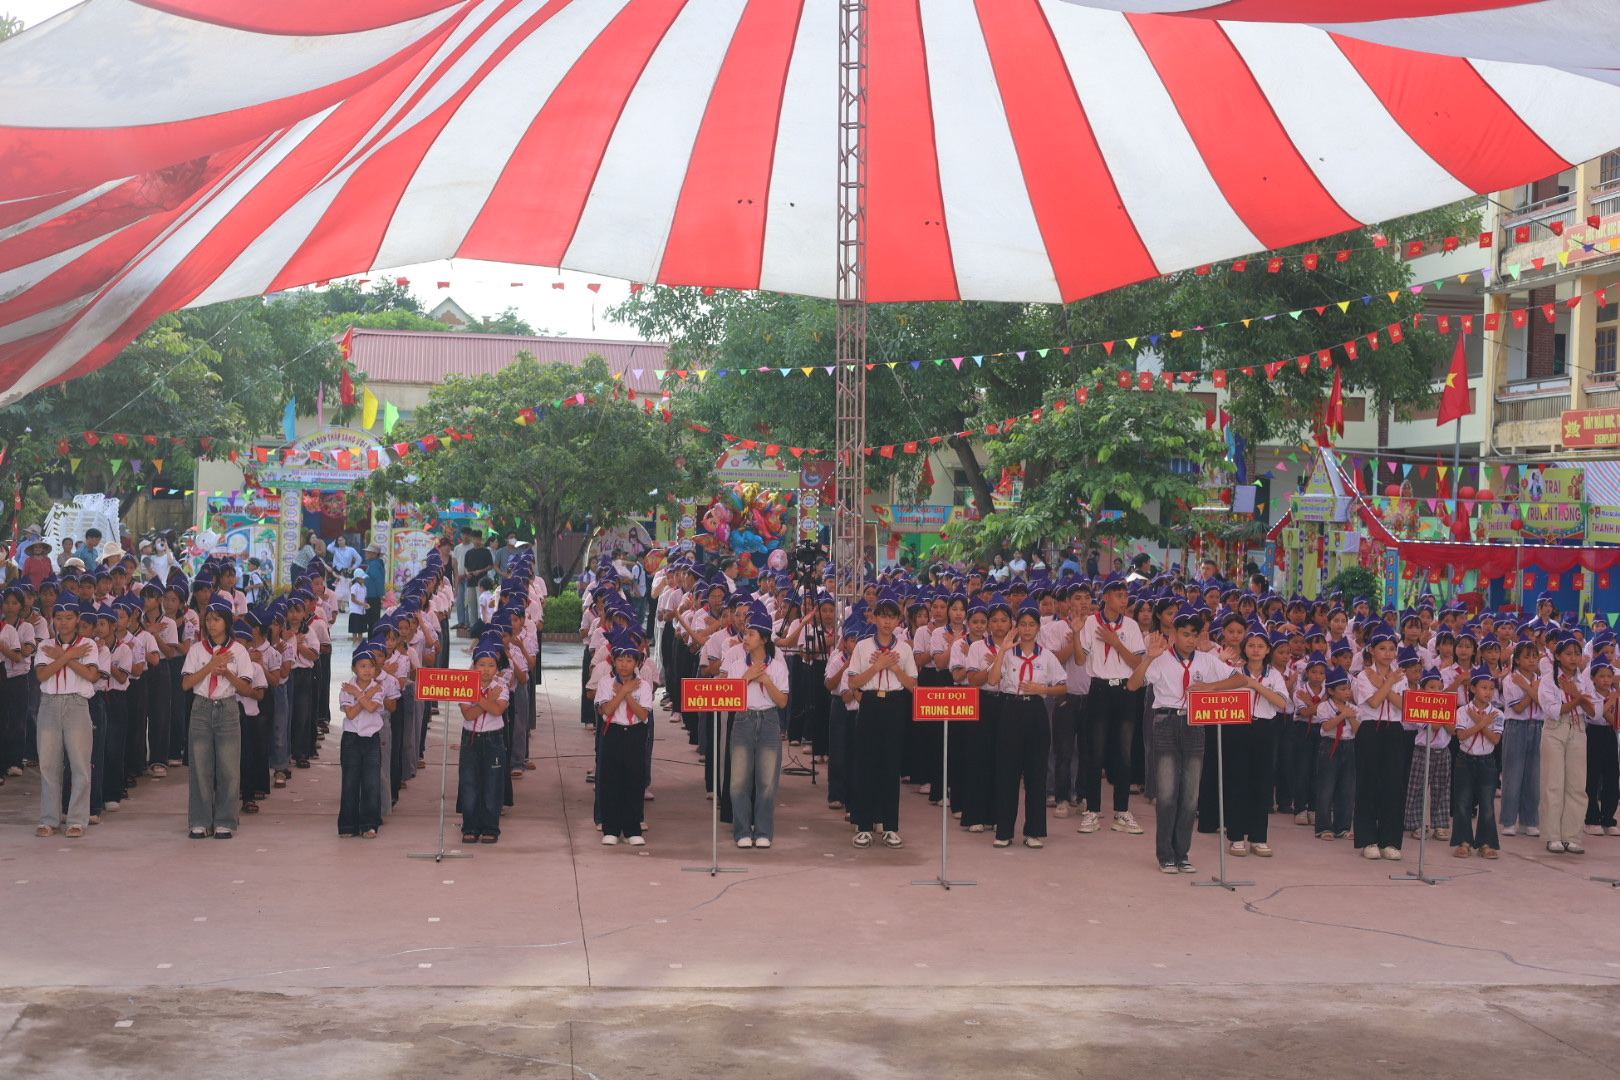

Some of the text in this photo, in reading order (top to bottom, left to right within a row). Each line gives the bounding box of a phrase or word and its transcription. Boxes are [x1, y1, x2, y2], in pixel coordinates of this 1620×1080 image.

[1545, 480, 1561, 498] TRẠI
[1591, 523, 1615, 534] THANH
[450, 674, 468, 683] ĐỘI
[694, 683, 733, 692] CHI ĐỘI
[927, 691, 967, 701] CHI ĐỘI
[1201, 696, 1239, 705] CHI ĐỘI
[1415, 695, 1448, 706] CHI ĐỘI
[687, 695, 742, 709] NỘI LANG
[920, 705, 975, 716] TRUNG LANG
[1195, 707, 1246, 721] AN TỨ HẠ
[1408, 707, 1451, 720] TAM BẢO
